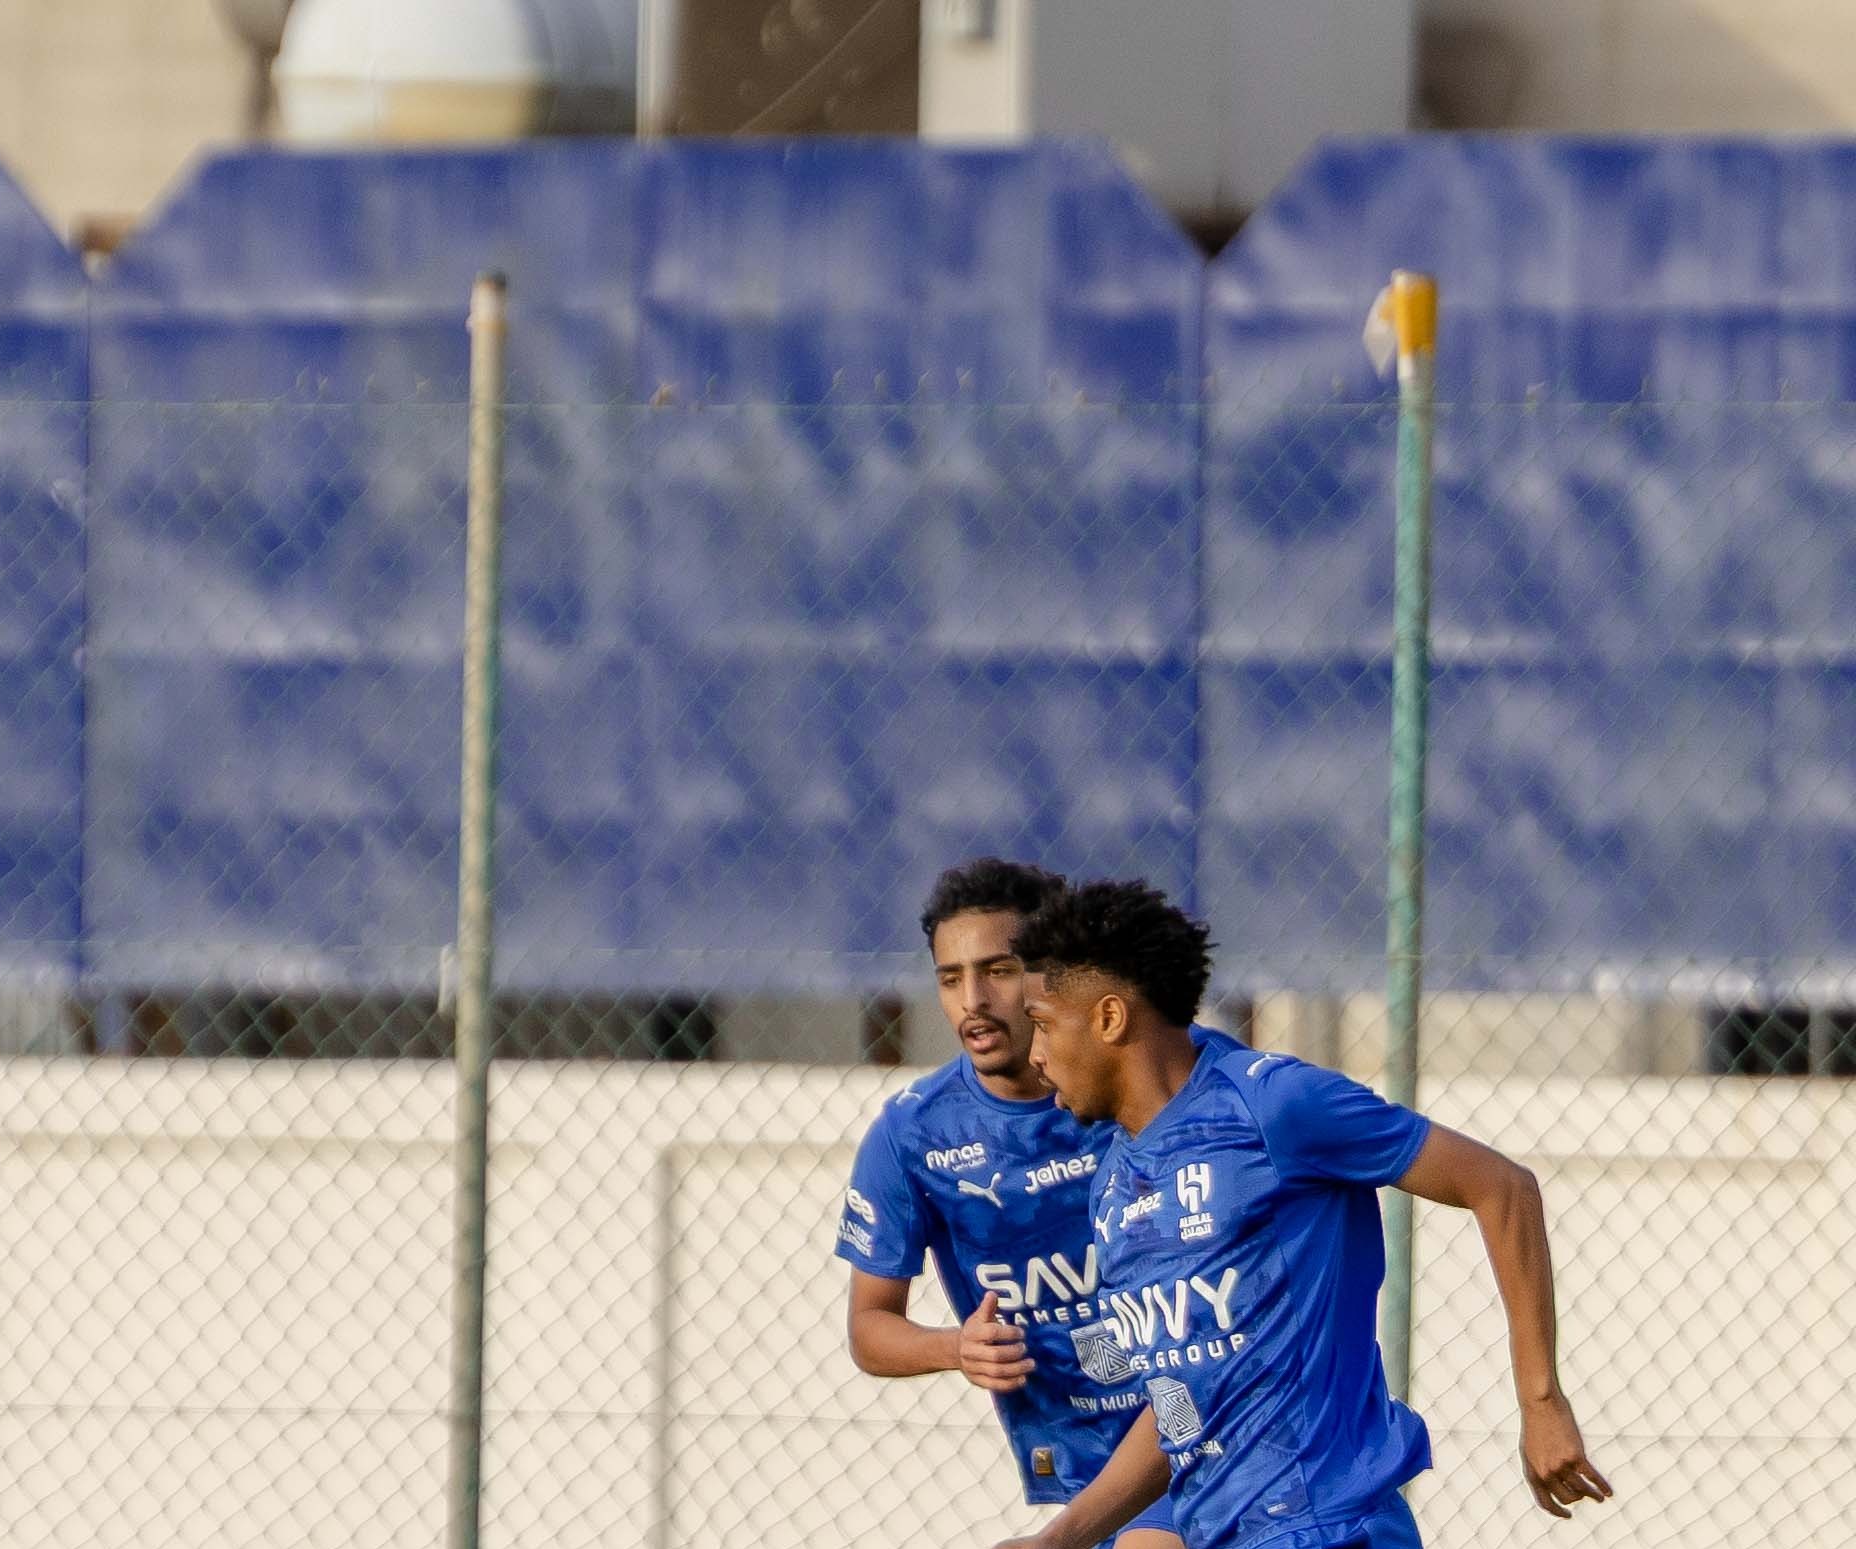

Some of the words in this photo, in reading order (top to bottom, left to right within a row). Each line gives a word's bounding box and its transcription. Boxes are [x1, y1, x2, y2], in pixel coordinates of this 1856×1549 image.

[925, 1142, 985, 1170] flynas
[975, 1243, 1097, 1310] SAV
[1155, 1333, 1245, 1368] GROUP
